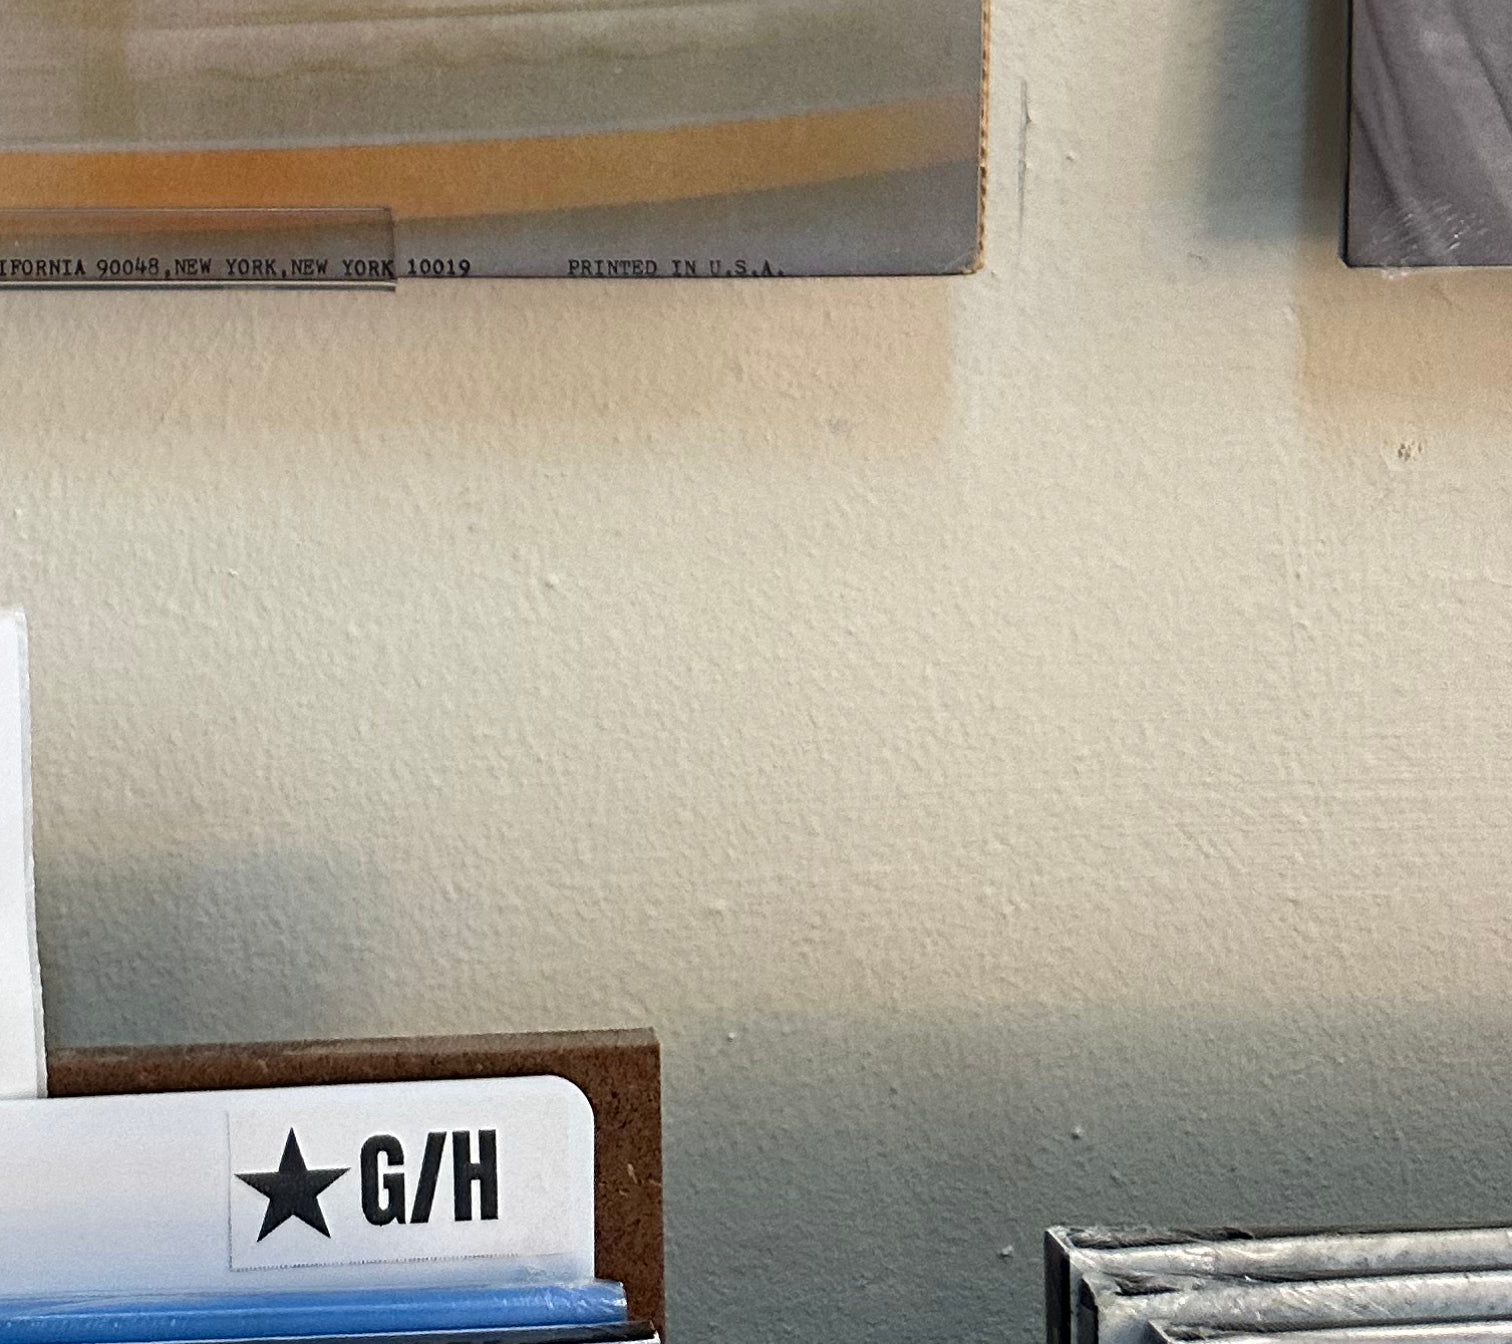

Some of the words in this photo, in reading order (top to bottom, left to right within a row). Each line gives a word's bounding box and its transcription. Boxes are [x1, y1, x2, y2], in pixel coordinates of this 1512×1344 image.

[226, 258, 329, 278] YORK,NEW
[343, 259, 395, 277] YORK
[407, 258, 471, 276] 10019
[567, 259, 658, 277] PRINTED
[672, 259, 696, 275] IN
[710, 259, 785, 277] U.S.A.
[360, 1129, 499, 1226] G/H
